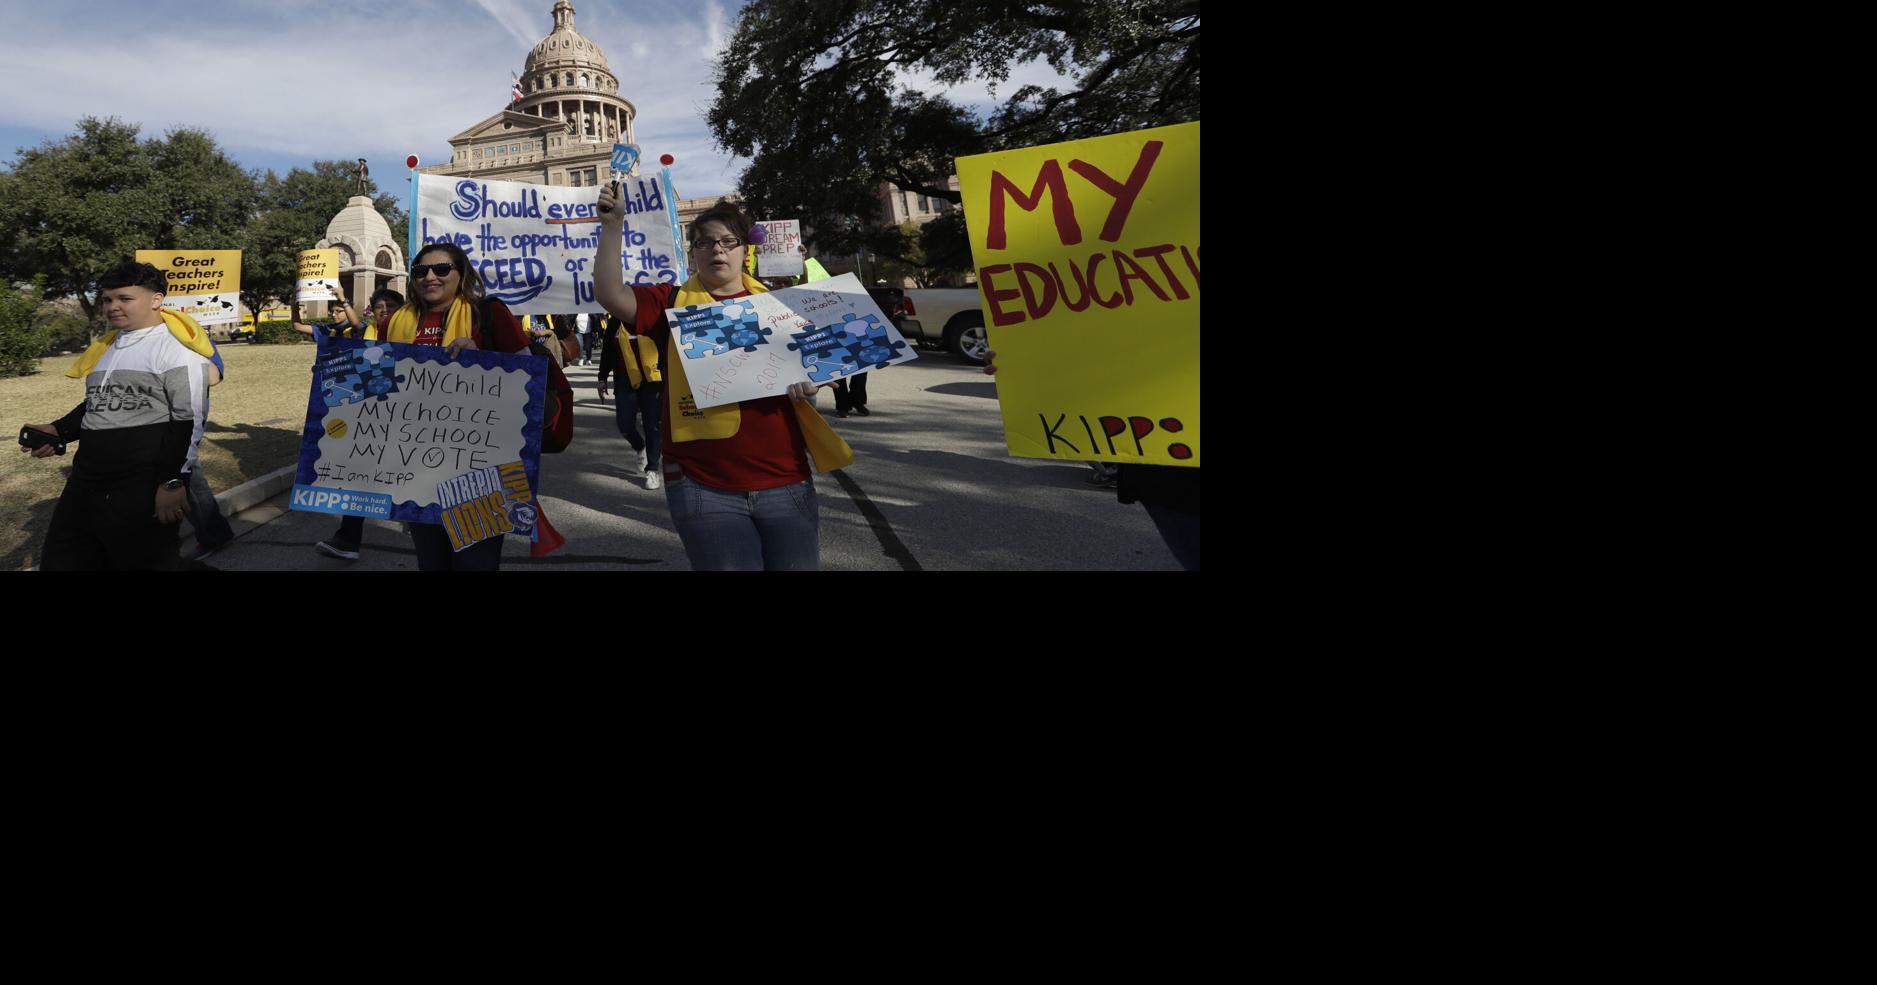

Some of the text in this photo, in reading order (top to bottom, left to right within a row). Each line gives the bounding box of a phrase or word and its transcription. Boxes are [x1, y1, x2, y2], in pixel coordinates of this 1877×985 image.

[450, 178, 664, 222] Should ever hild
[986, 140, 1164, 250] MY
[476, 223, 507, 251] the
[622, 220, 646, 247] to
[763, 243, 794, 255] PREP
[172, 256, 216, 267] Great
[565, 258, 588, 272] or
[636, 247, 670, 270] the
[168, 280, 220, 294] nspire!
[980, 244, 1201, 327] EDUCATI
[425, 327, 442, 335] KIP
[757, 352, 785, 390] 2017
[354, 421, 389, 442] MY
[399, 423, 500, 449] SCHOOL
[1038, 413, 1193, 460] KIPP:
[349, 443, 488, 471] MY VOTE
[294, 488, 388, 511] KIPP: Work hard.
[350, 502, 388, 515] Be nice.
[441, 490, 514, 552] LIONS
